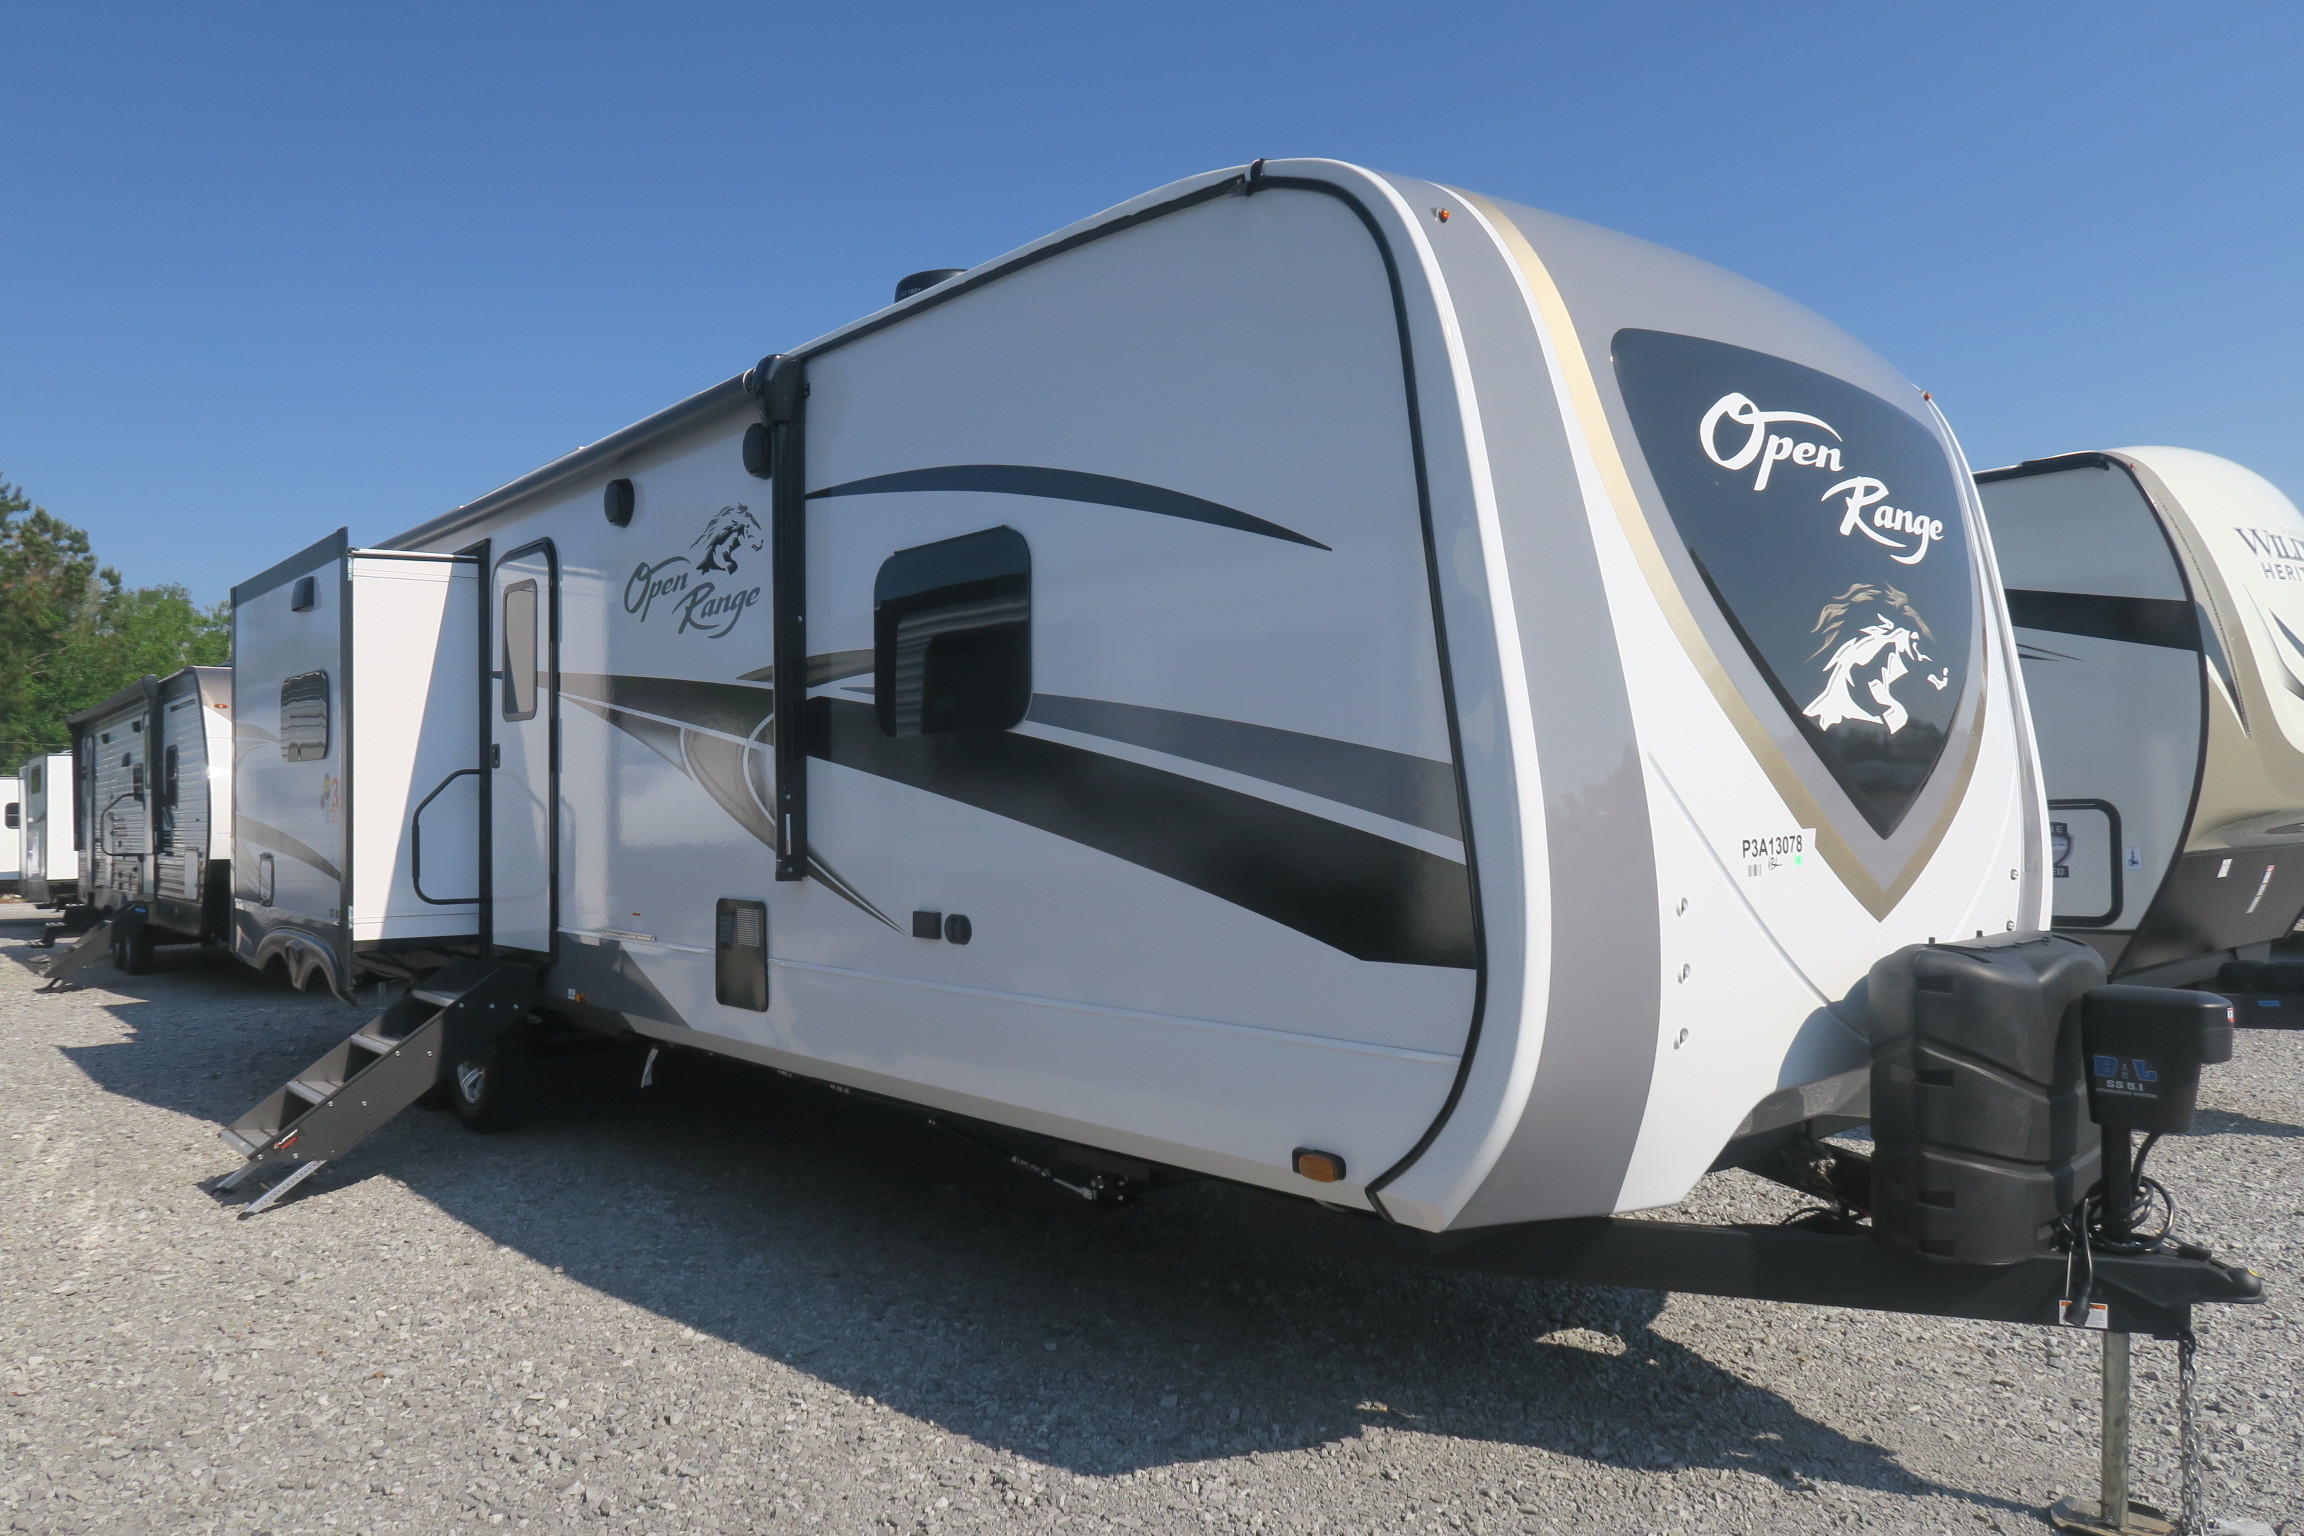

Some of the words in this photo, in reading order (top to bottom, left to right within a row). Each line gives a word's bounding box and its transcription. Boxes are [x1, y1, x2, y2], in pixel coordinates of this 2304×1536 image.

[1700, 392, 1844, 491] Open
[1821, 476, 1944, 564] Range
[624, 555, 691, 623] Open
[671, 581, 761, 639] Range
[1742, 834, 1803, 858] P3A13078
[2106, 1079, 2124, 1090] SS
